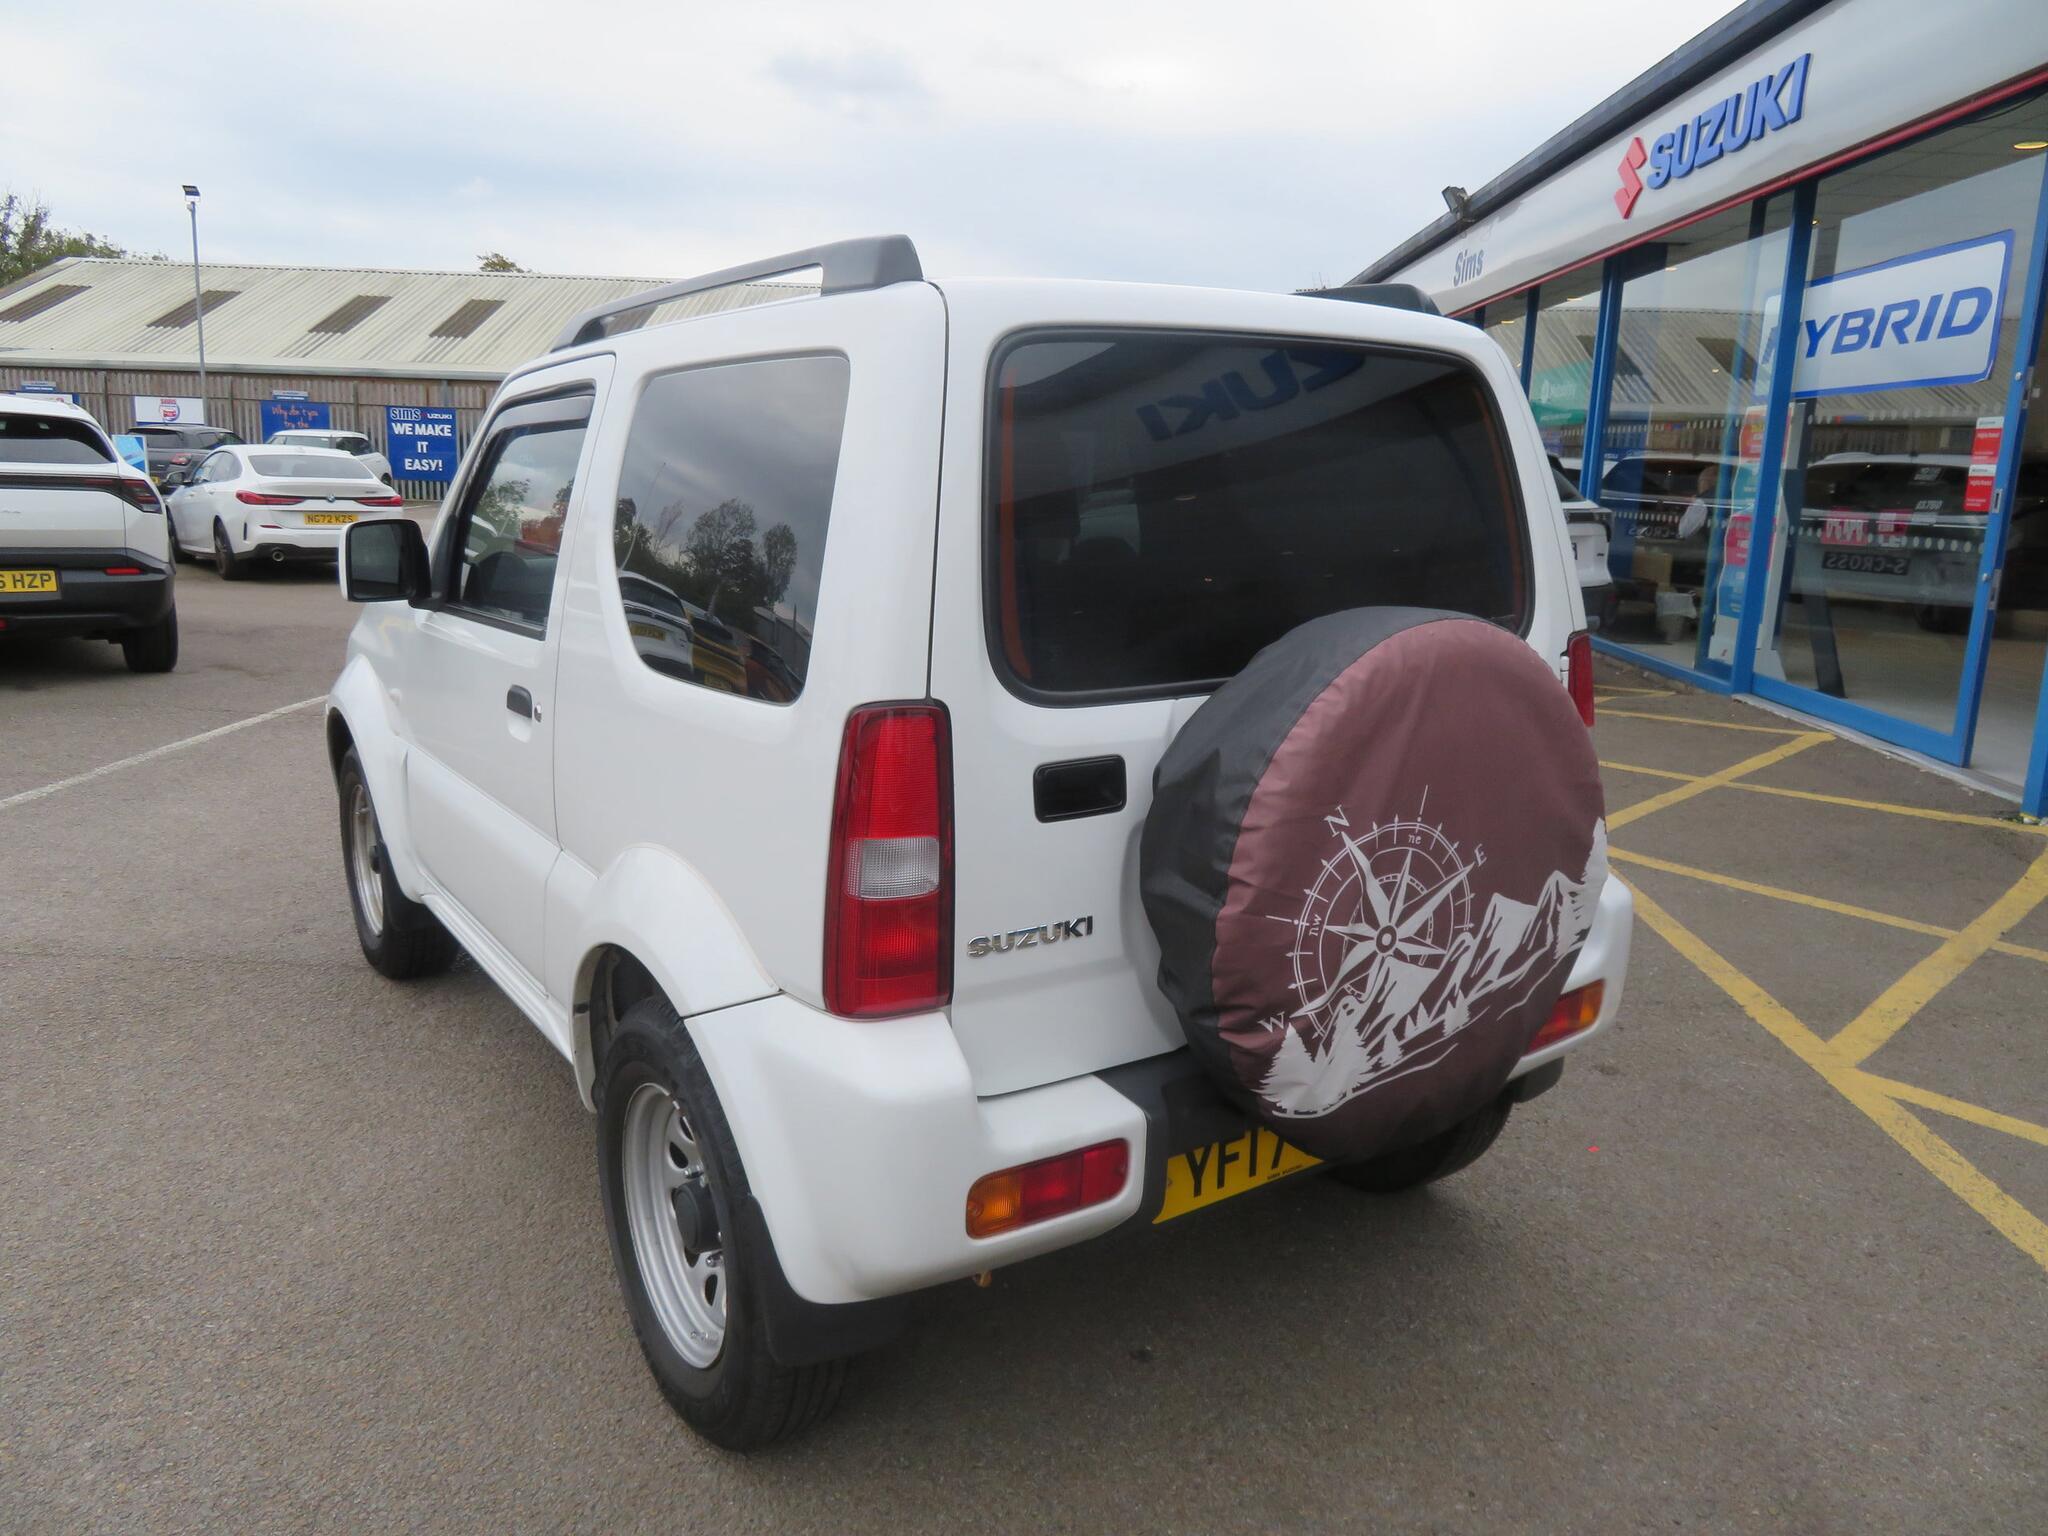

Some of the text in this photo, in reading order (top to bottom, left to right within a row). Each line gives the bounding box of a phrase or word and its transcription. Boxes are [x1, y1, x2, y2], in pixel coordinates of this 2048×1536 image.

[1647, 53, 1811, 190] SUZUKI
[1453, 249, 1484, 287] Sims
[391, 422, 452, 437] WE MAKE
[417, 441, 428, 453] IT
[404, 458, 443, 471] EASY!
[12, 573, 52, 589] HZP
[1324, 805, 1350, 837] N
[1474, 843, 1488, 867] E
[967, 915, 1093, 958] SUZUKI
[1258, 1012, 1286, 1034] W
